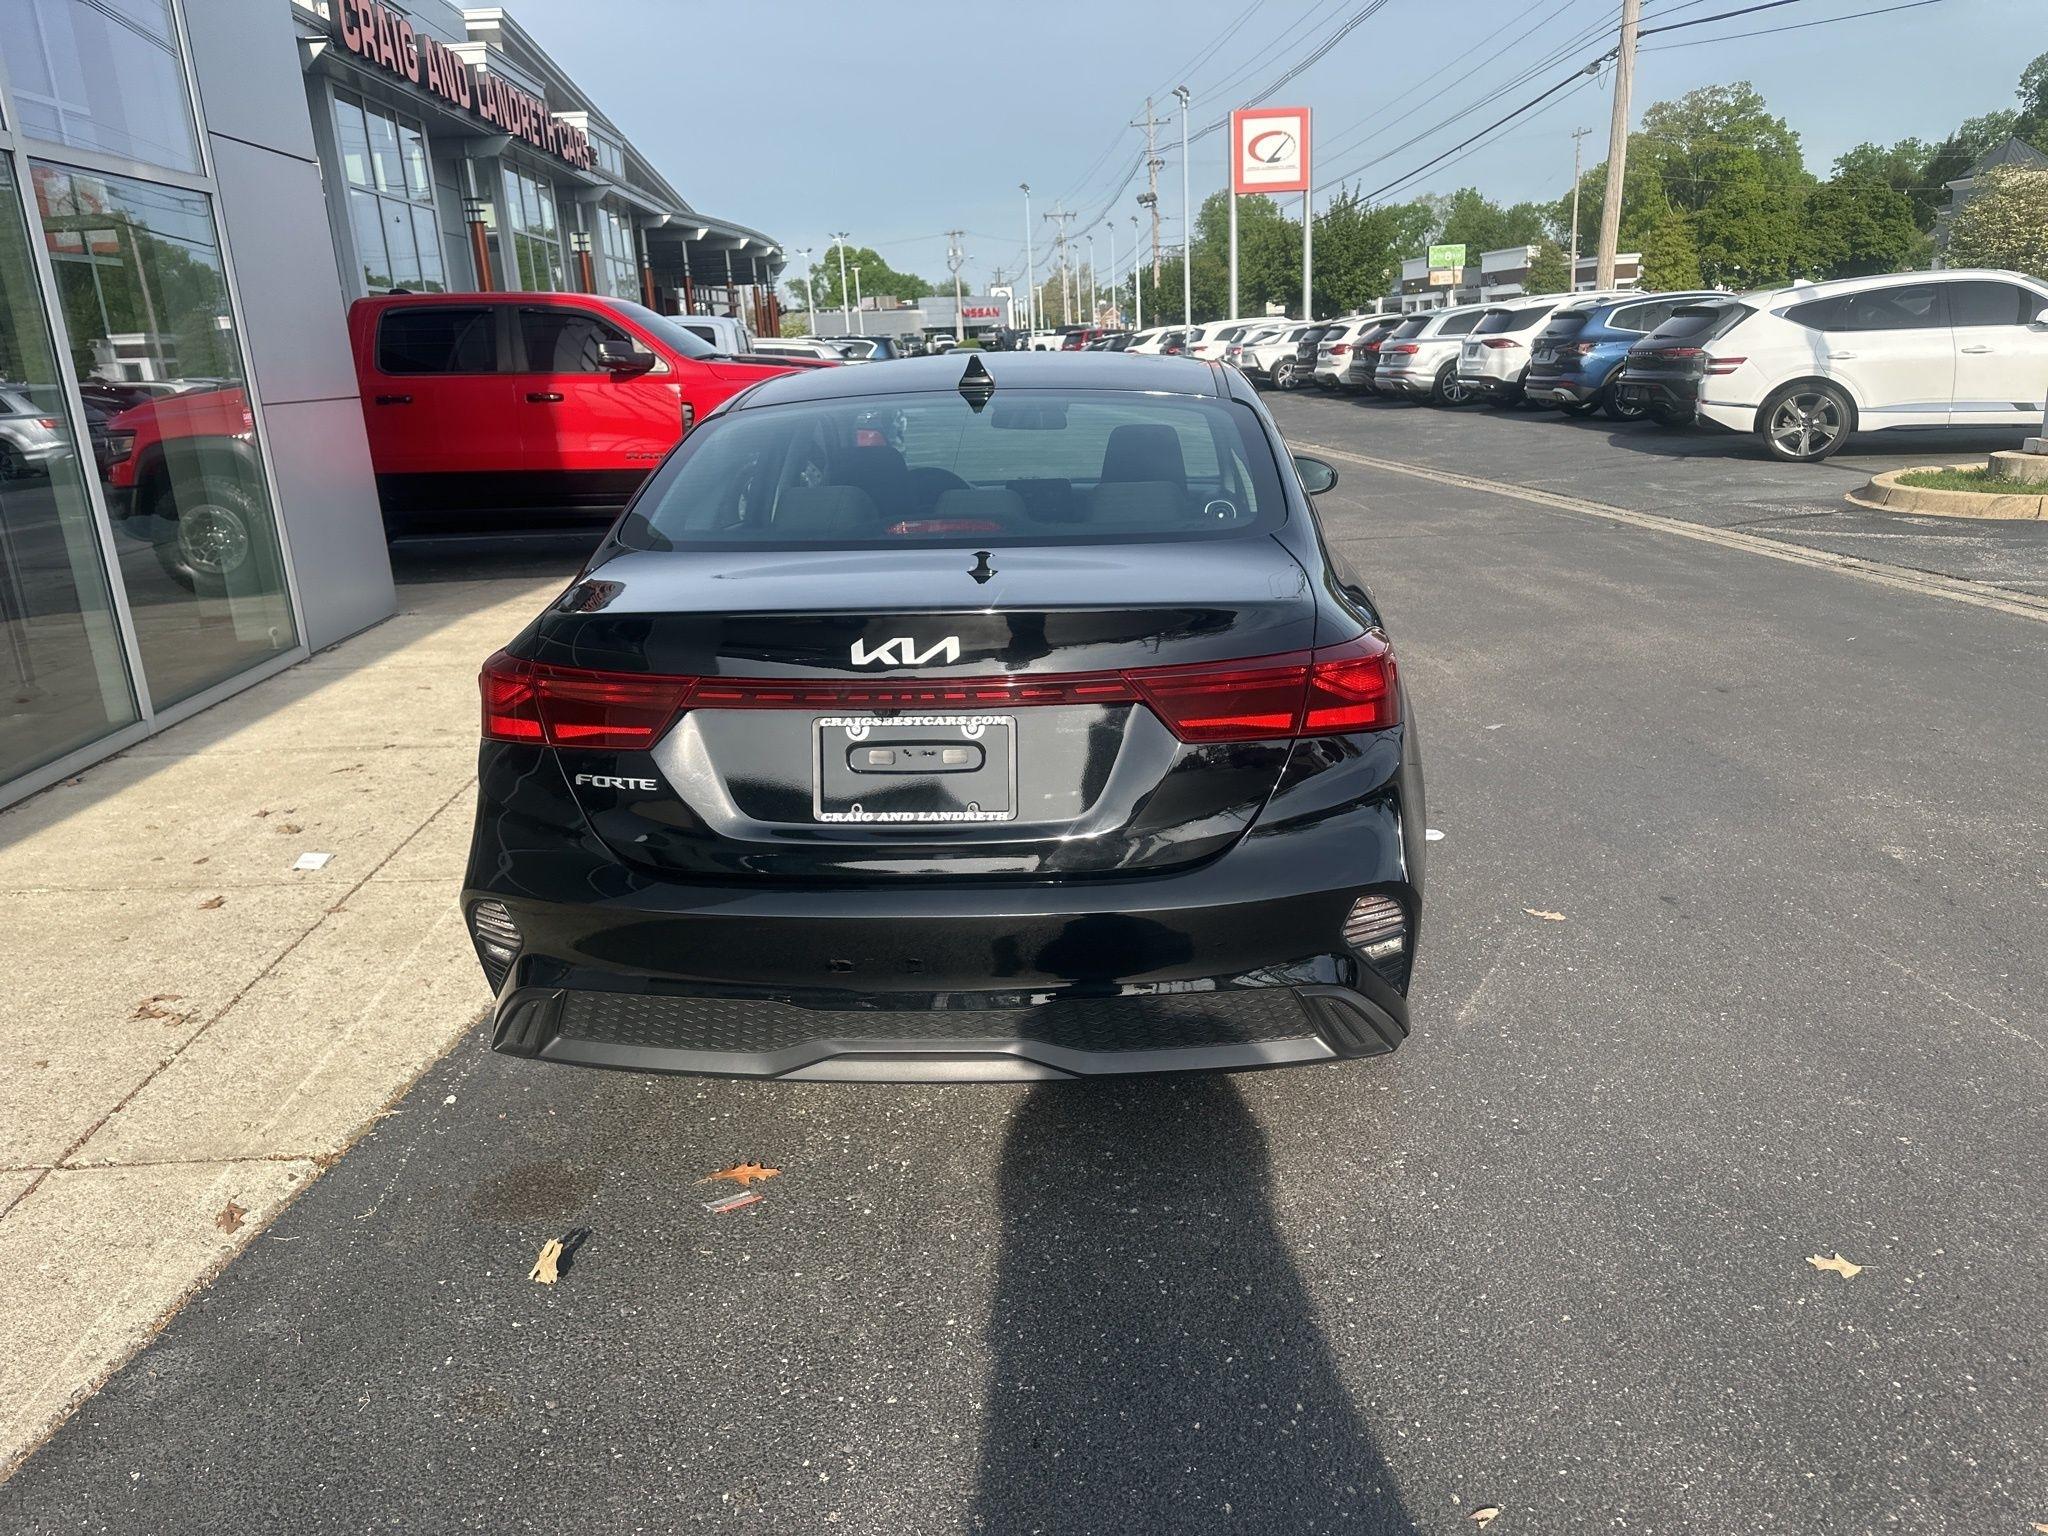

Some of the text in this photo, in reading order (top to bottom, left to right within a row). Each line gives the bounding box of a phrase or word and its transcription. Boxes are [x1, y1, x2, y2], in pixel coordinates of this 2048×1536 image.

[339, 0, 591, 171] CRAIG AND LANDRETH CARS
[851, 636, 961, 665] KIA
[820, 716, 1008, 727] CRAIGSBESTCARS.COM
[575, 773, 658, 791] FORTE
[820, 811, 1010, 822] CRAIG AND LANDRETH
